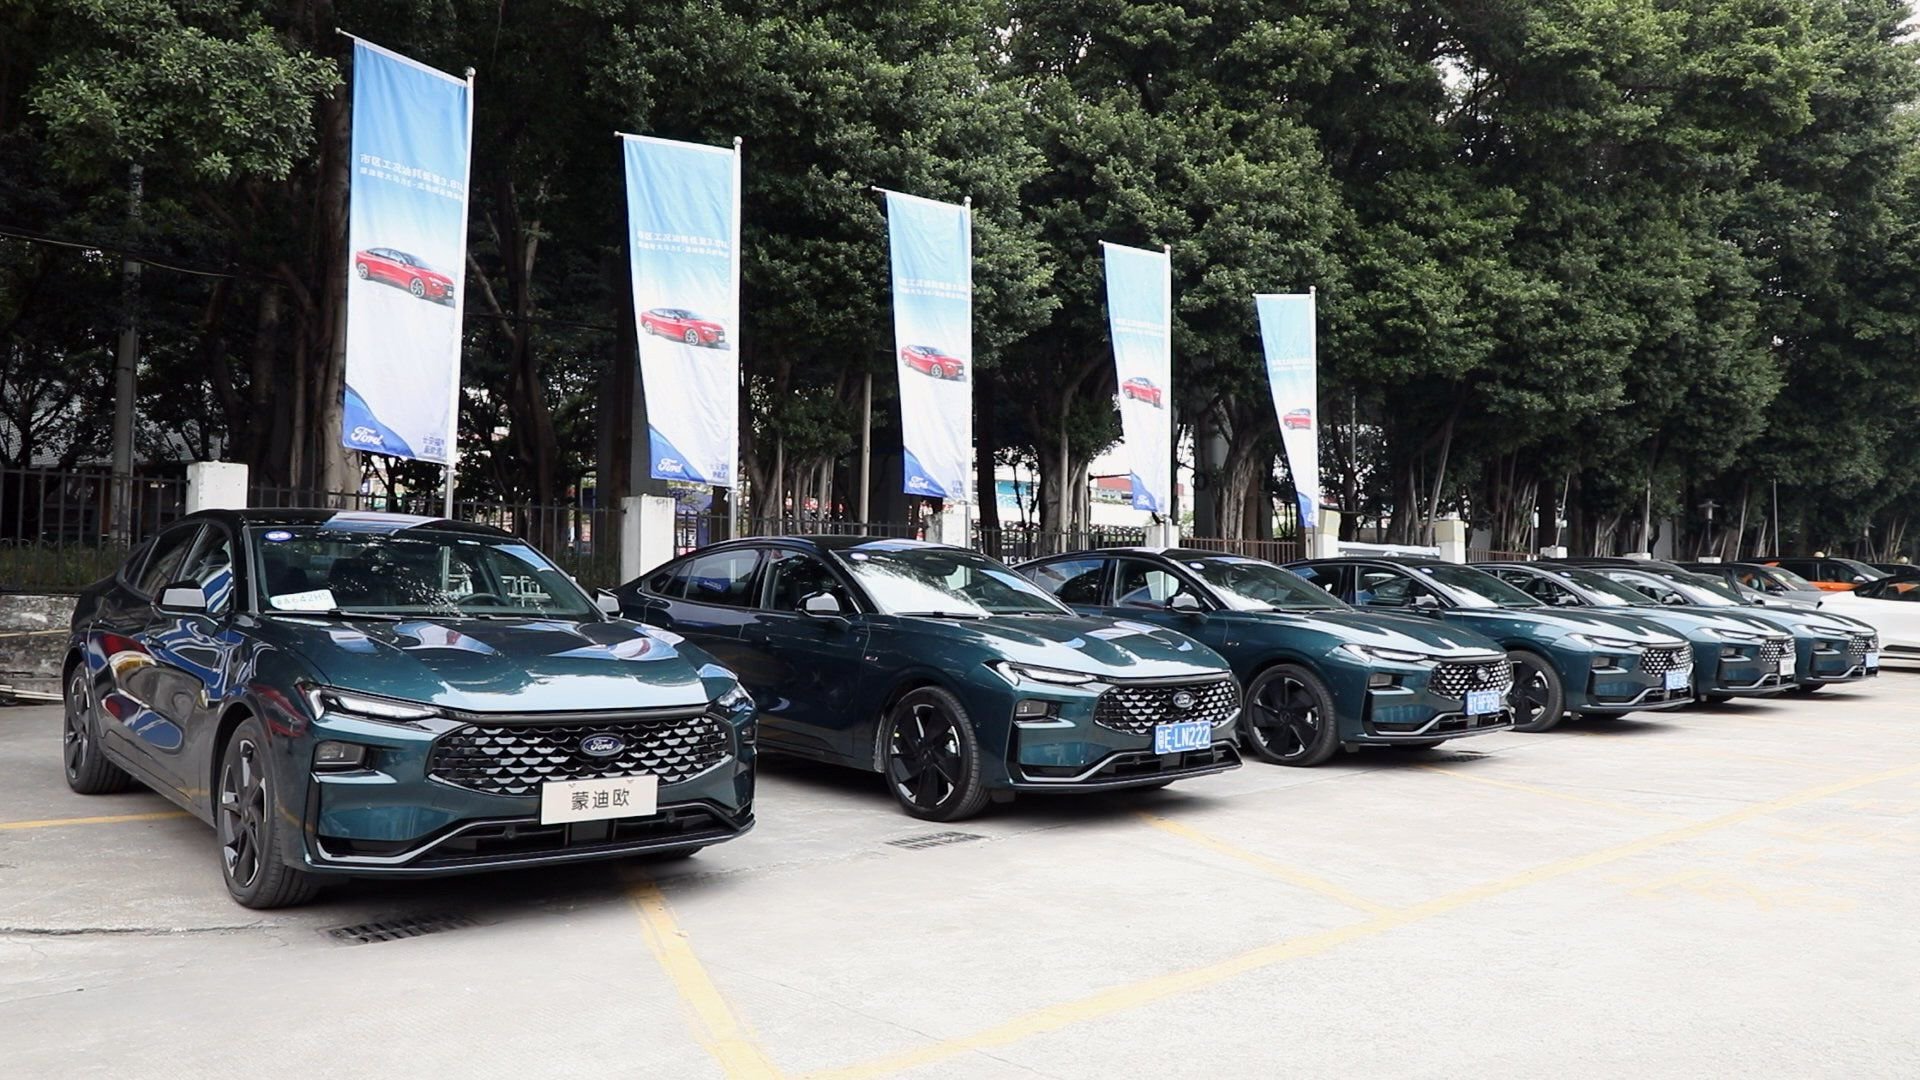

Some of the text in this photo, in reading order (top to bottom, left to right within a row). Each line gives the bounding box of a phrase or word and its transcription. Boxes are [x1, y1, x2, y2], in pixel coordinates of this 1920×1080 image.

[351, 426, 384, 446] Ford
[657, 458, 683, 473] Ford
[590, 739, 614, 751] Ford
[571, 788, 630, 811] 蒙迪欧
